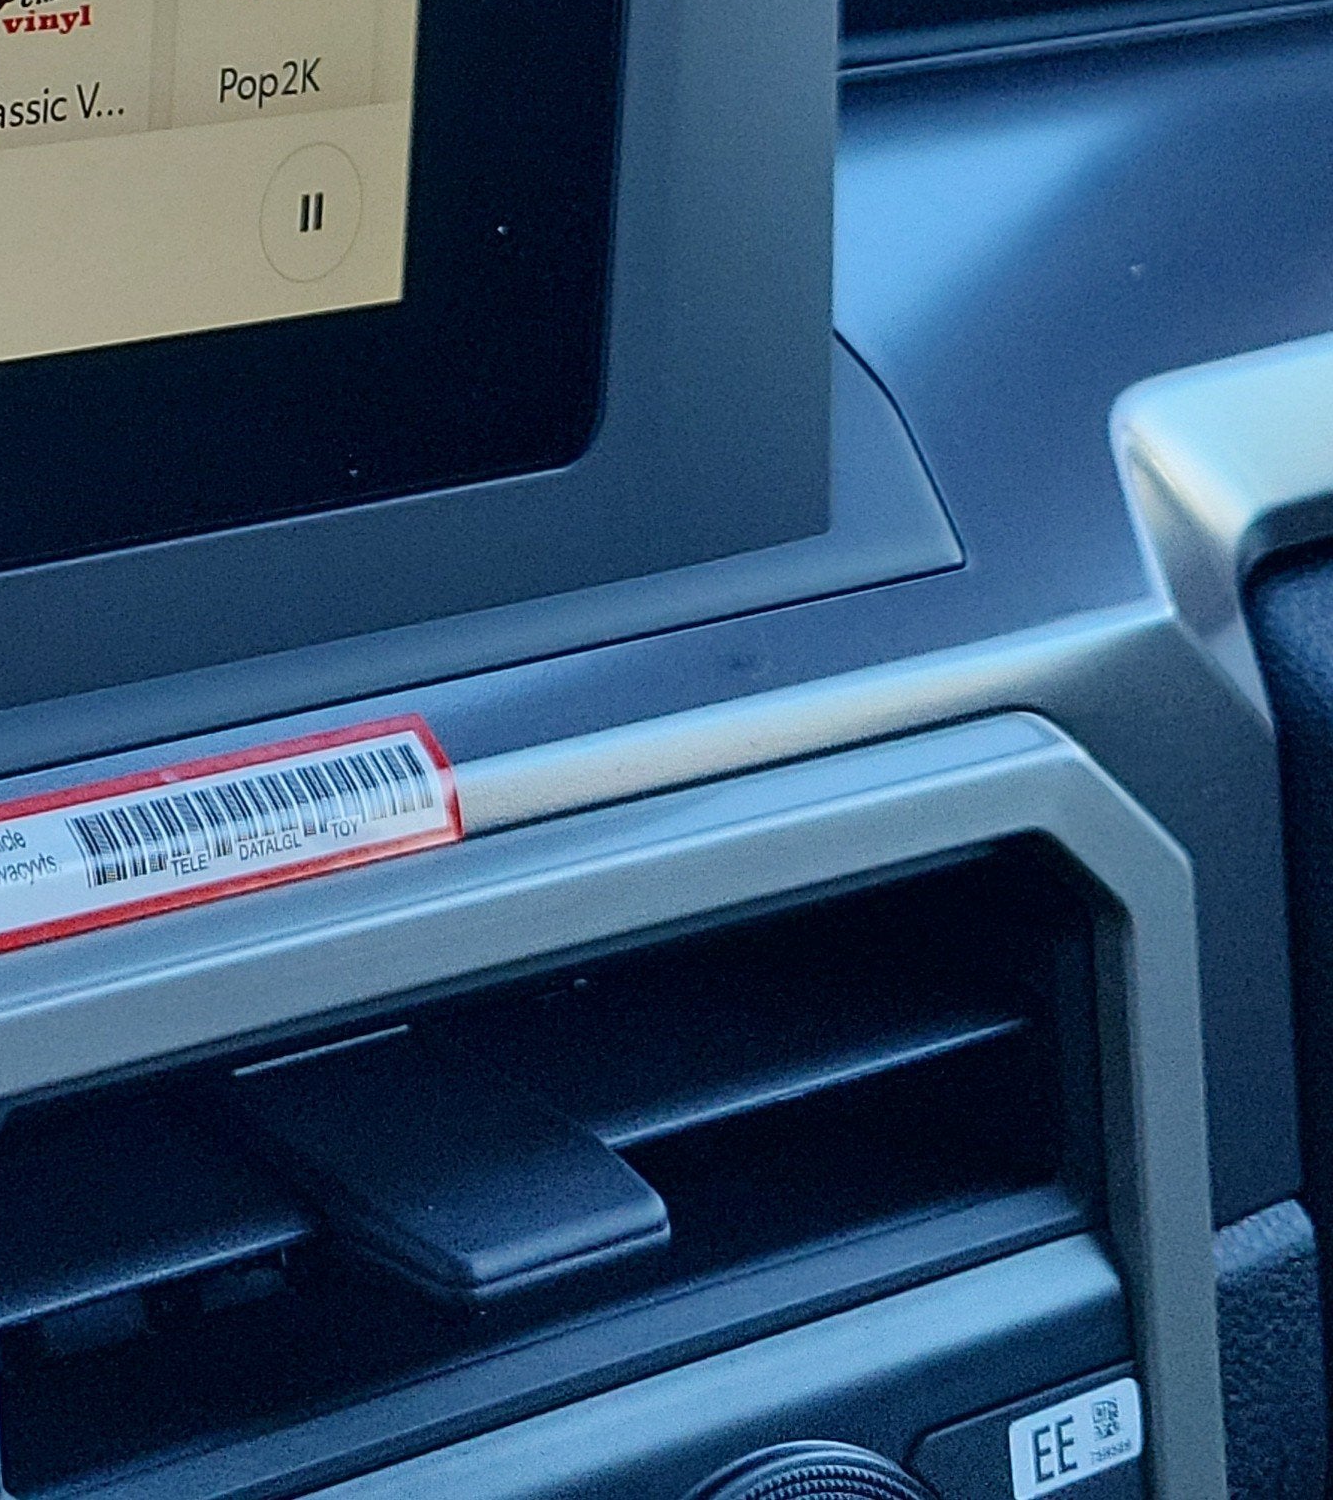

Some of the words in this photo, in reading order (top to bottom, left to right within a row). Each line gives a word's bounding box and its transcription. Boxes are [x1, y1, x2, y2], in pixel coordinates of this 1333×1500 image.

[1, 4, 91, 34] vinyl
[76, 82, 126, 120] V...
[218, 57, 321, 110] Pop2K
[170, 853, 208, 878] TELE
[330, 818, 360, 840] TOY
[1031, 1413, 1078, 1483] EE
